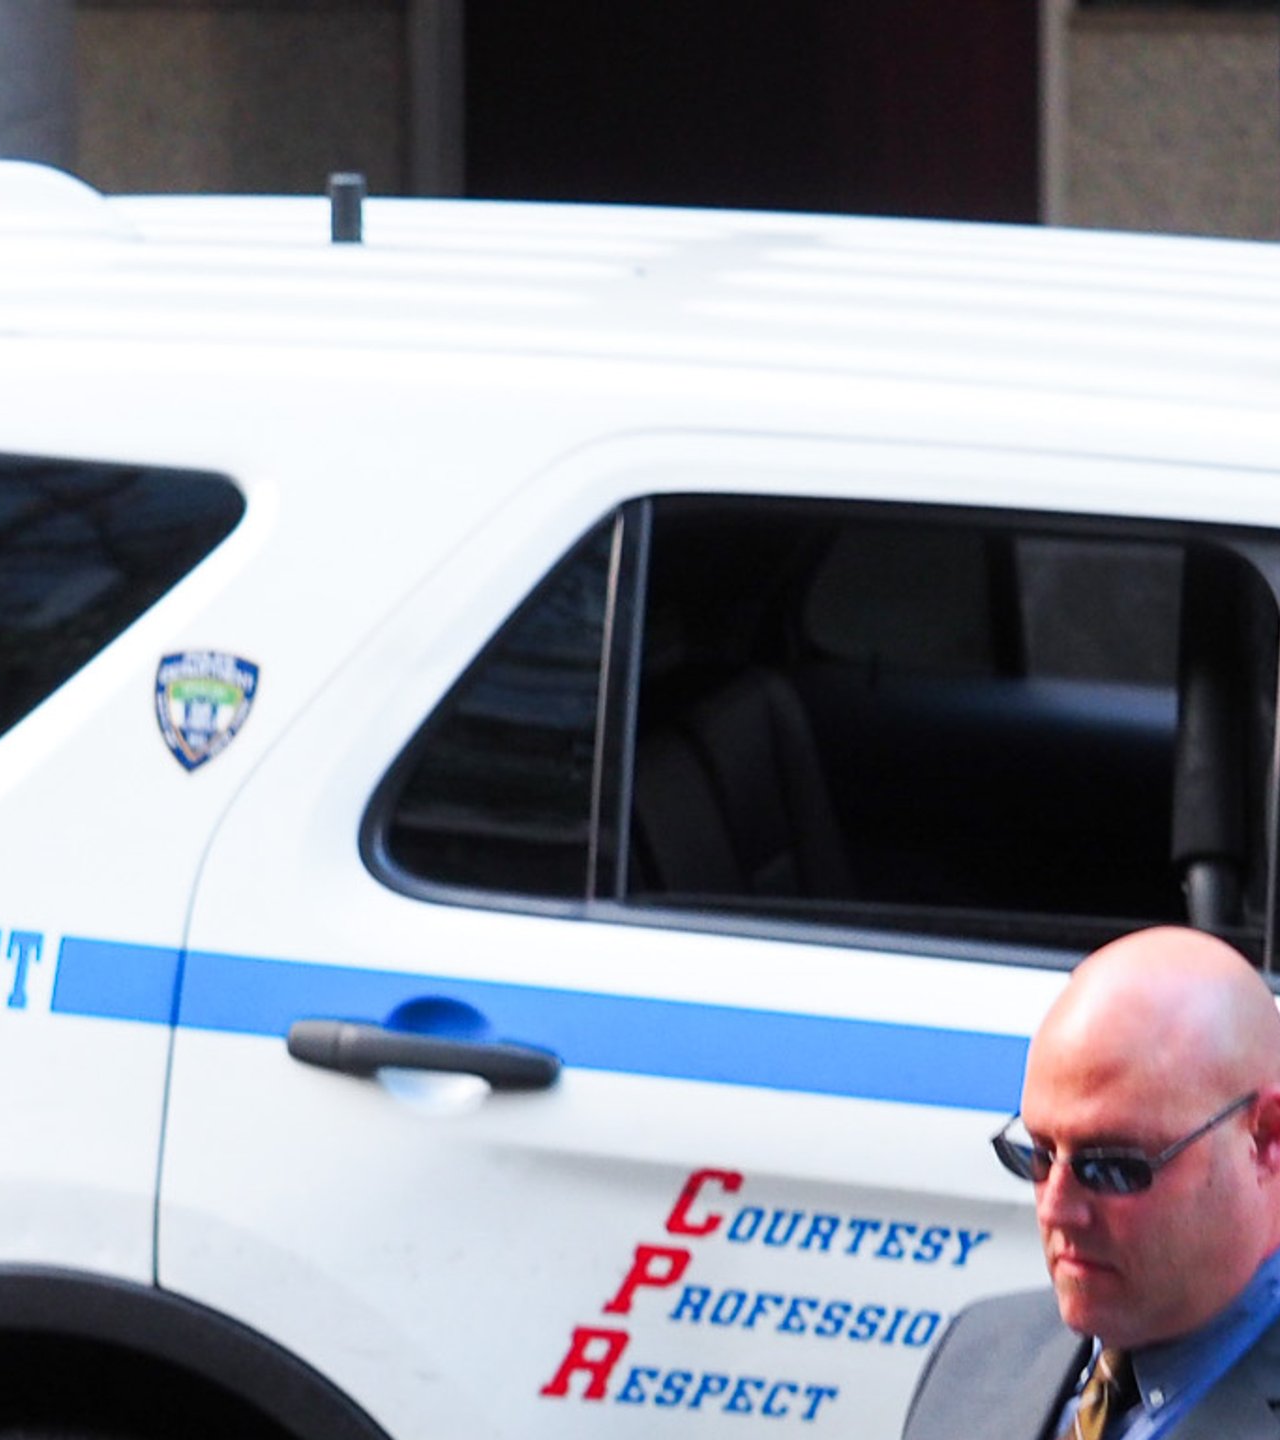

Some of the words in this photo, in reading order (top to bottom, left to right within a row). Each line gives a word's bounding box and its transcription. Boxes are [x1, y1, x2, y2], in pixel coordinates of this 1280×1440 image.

[664, 1167, 993, 1269] COURTESY
[603, 1243, 956, 1348] PROFESSIO
[540, 1326, 841, 1424] RESPECT
